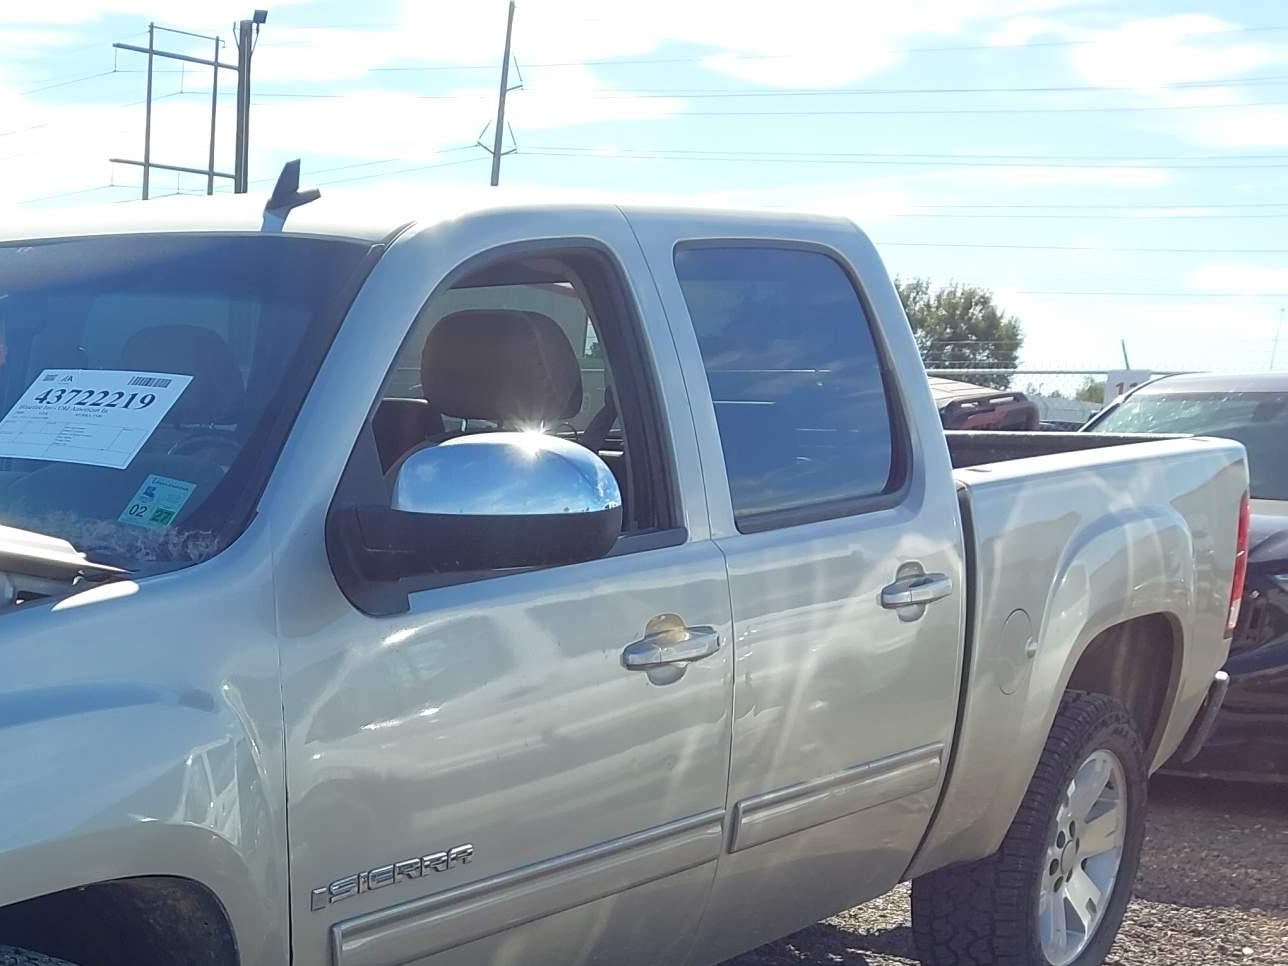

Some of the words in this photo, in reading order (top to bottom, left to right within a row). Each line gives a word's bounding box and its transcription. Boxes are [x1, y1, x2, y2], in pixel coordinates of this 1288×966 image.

[34, 388, 156, 410] 43722219
[128, 503, 148, 518] 02
[328, 843, 473, 904] SIERRA
